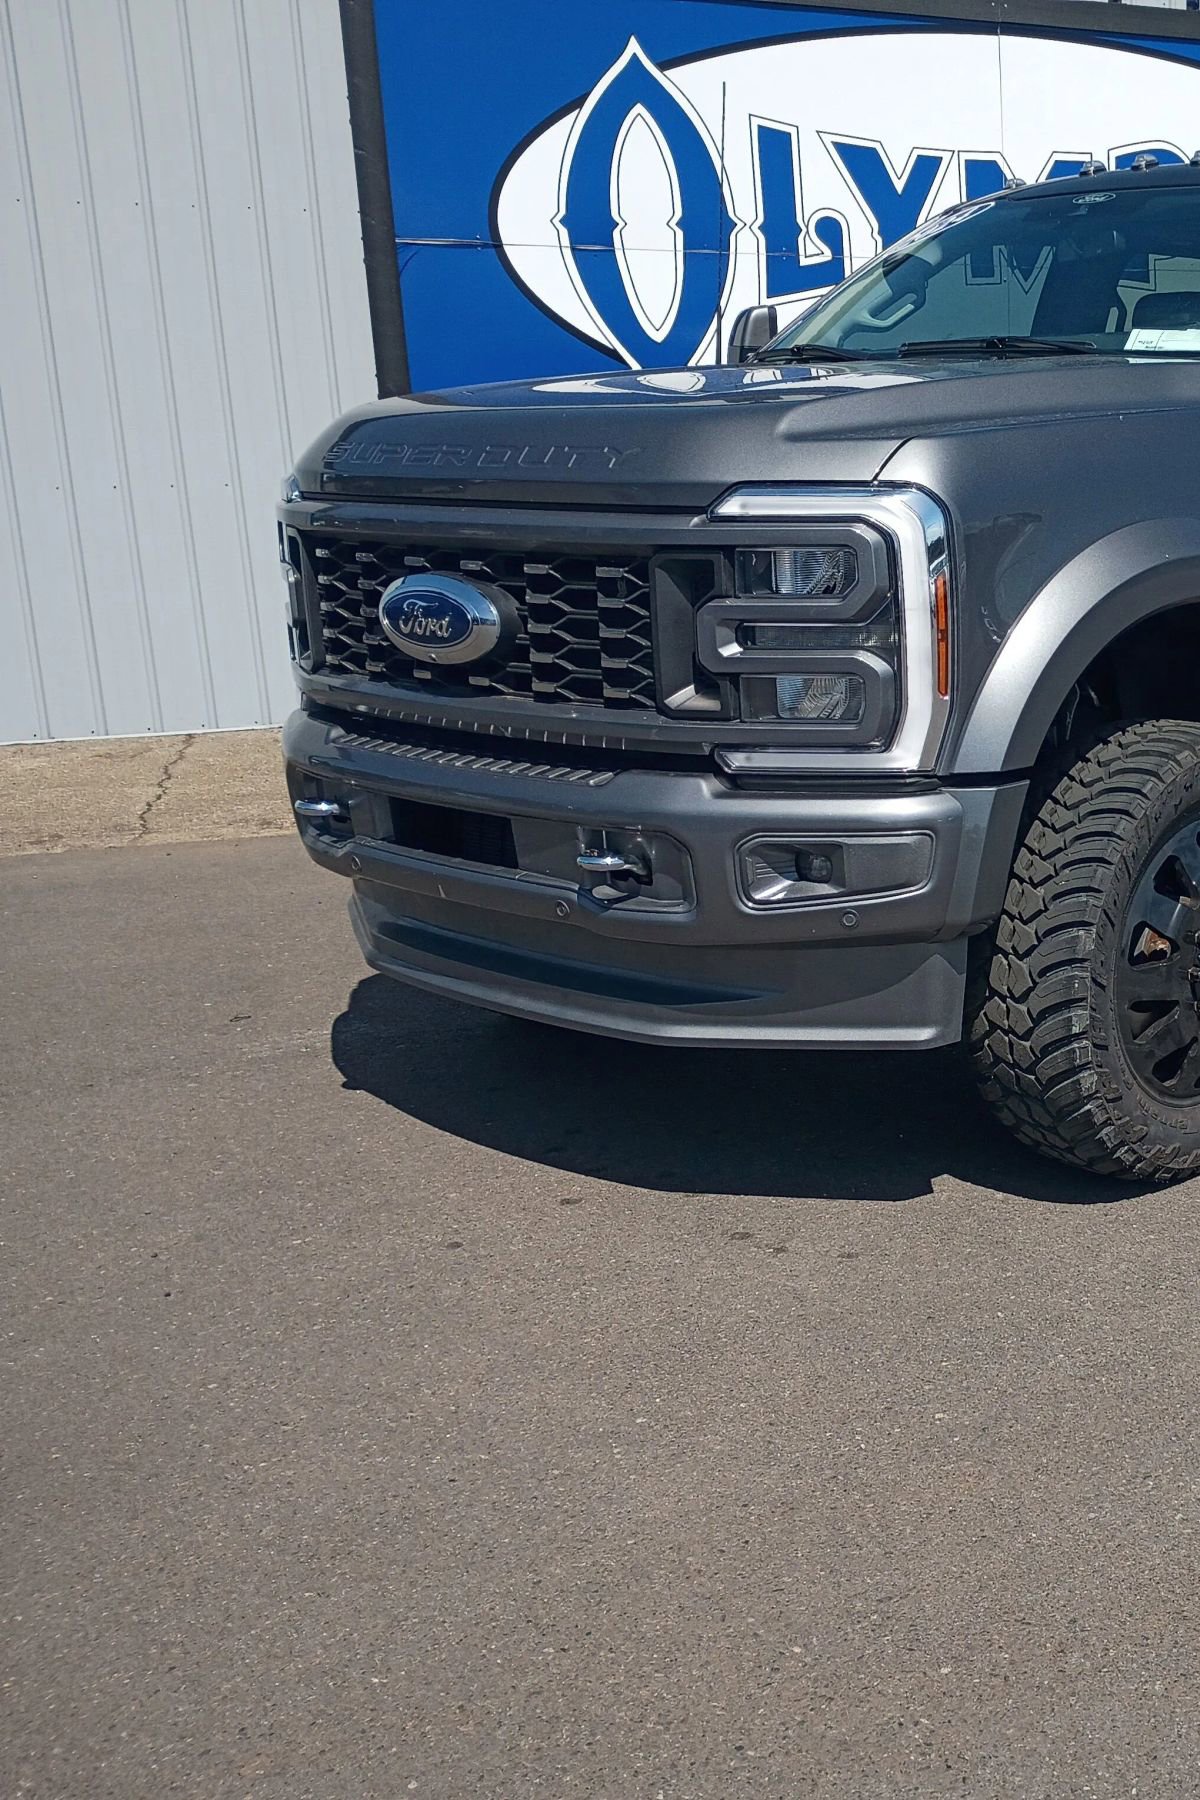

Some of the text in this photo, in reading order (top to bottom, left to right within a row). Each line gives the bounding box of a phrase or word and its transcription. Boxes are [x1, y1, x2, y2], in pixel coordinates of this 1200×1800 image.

[322, 441, 640, 469] SUPER DUTY
[396, 599, 452, 638] Ford
